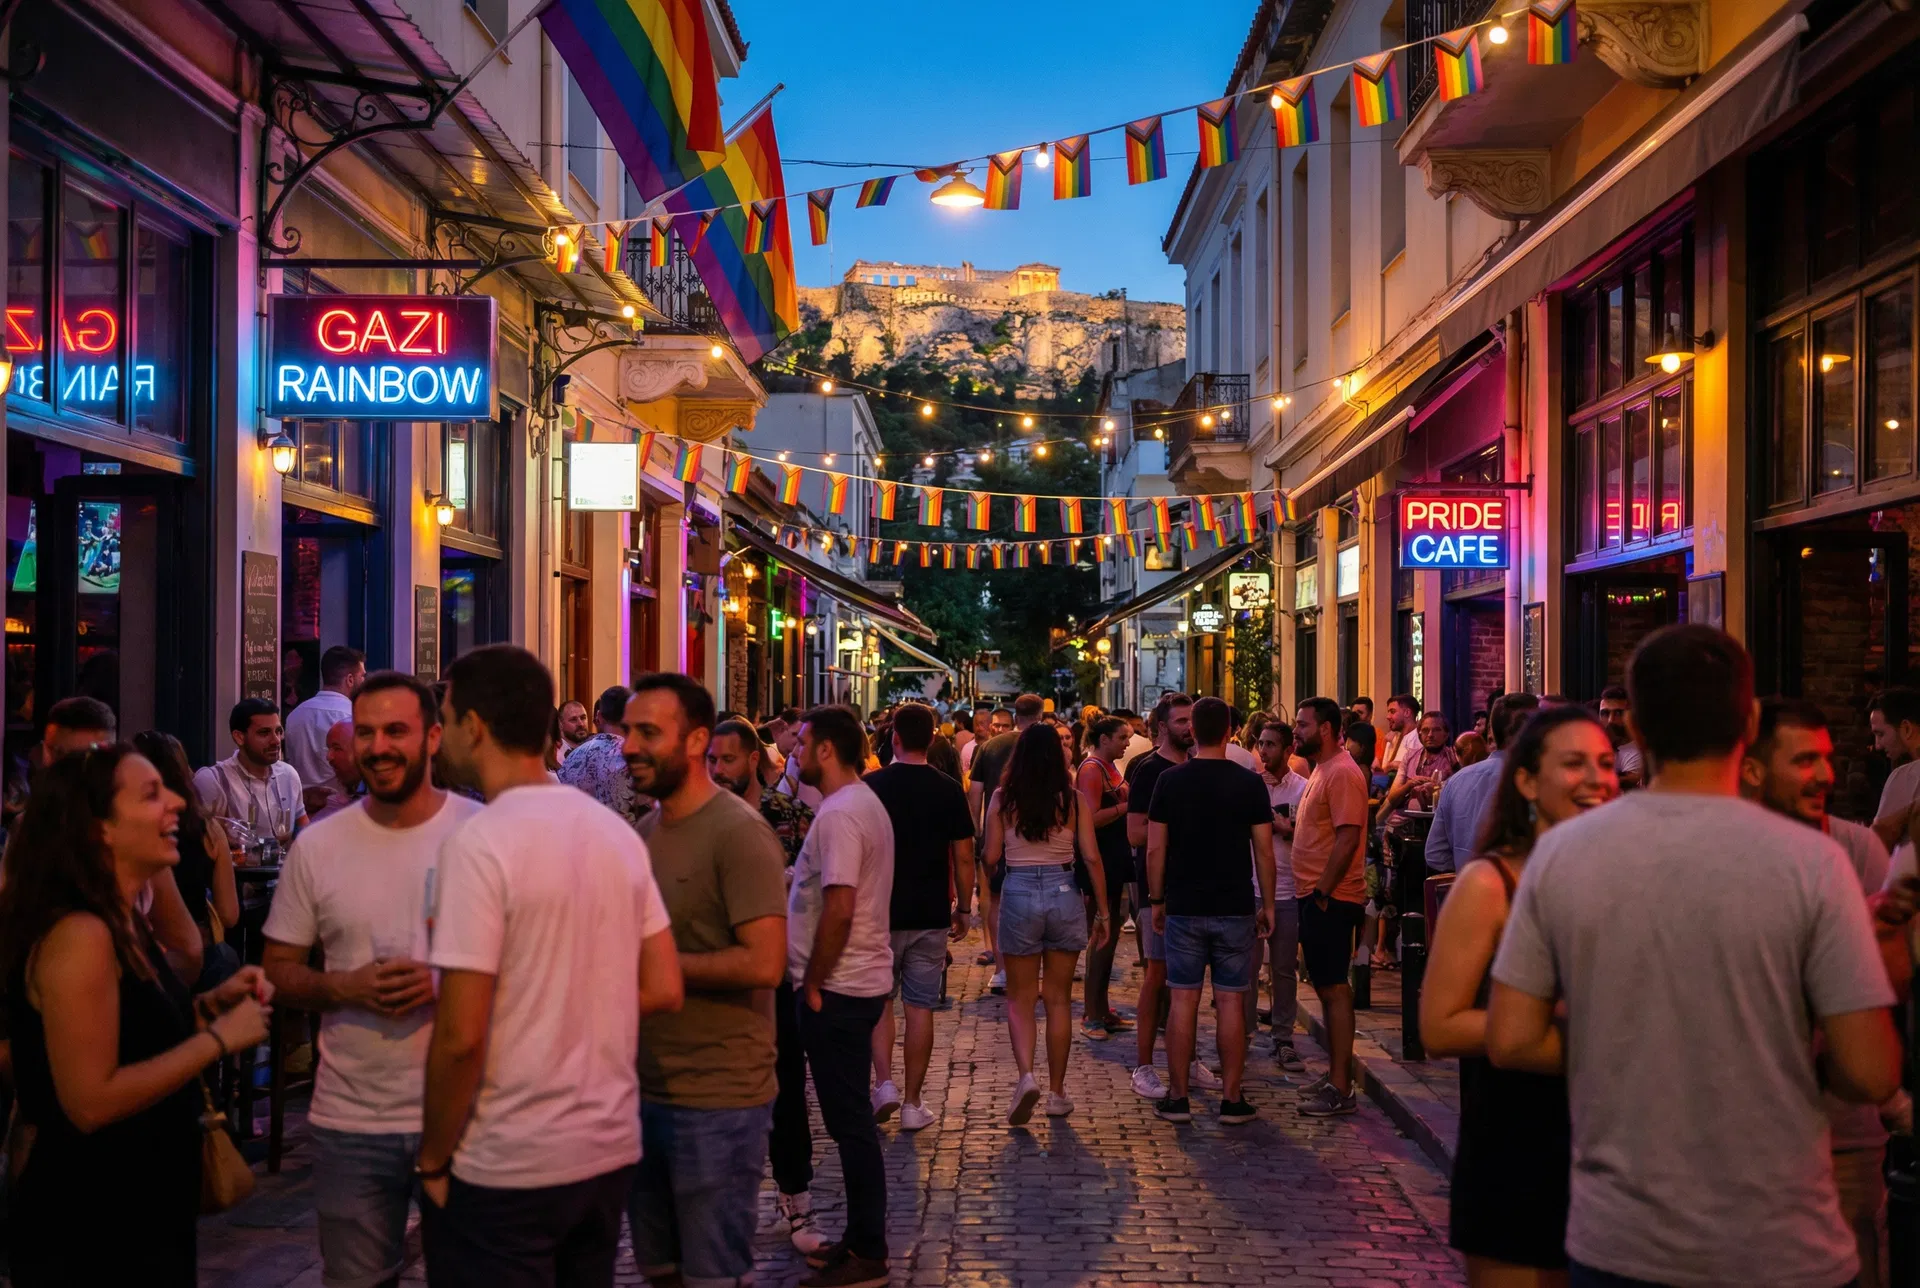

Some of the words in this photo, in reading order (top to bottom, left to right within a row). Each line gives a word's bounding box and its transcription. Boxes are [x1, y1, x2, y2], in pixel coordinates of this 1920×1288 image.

[317, 309, 447, 354] GAZI
[278, 365, 482, 403] RAINBOW
[1407, 502, 1502, 530] PRIDE
[1411, 535, 1498, 564] CAFE
